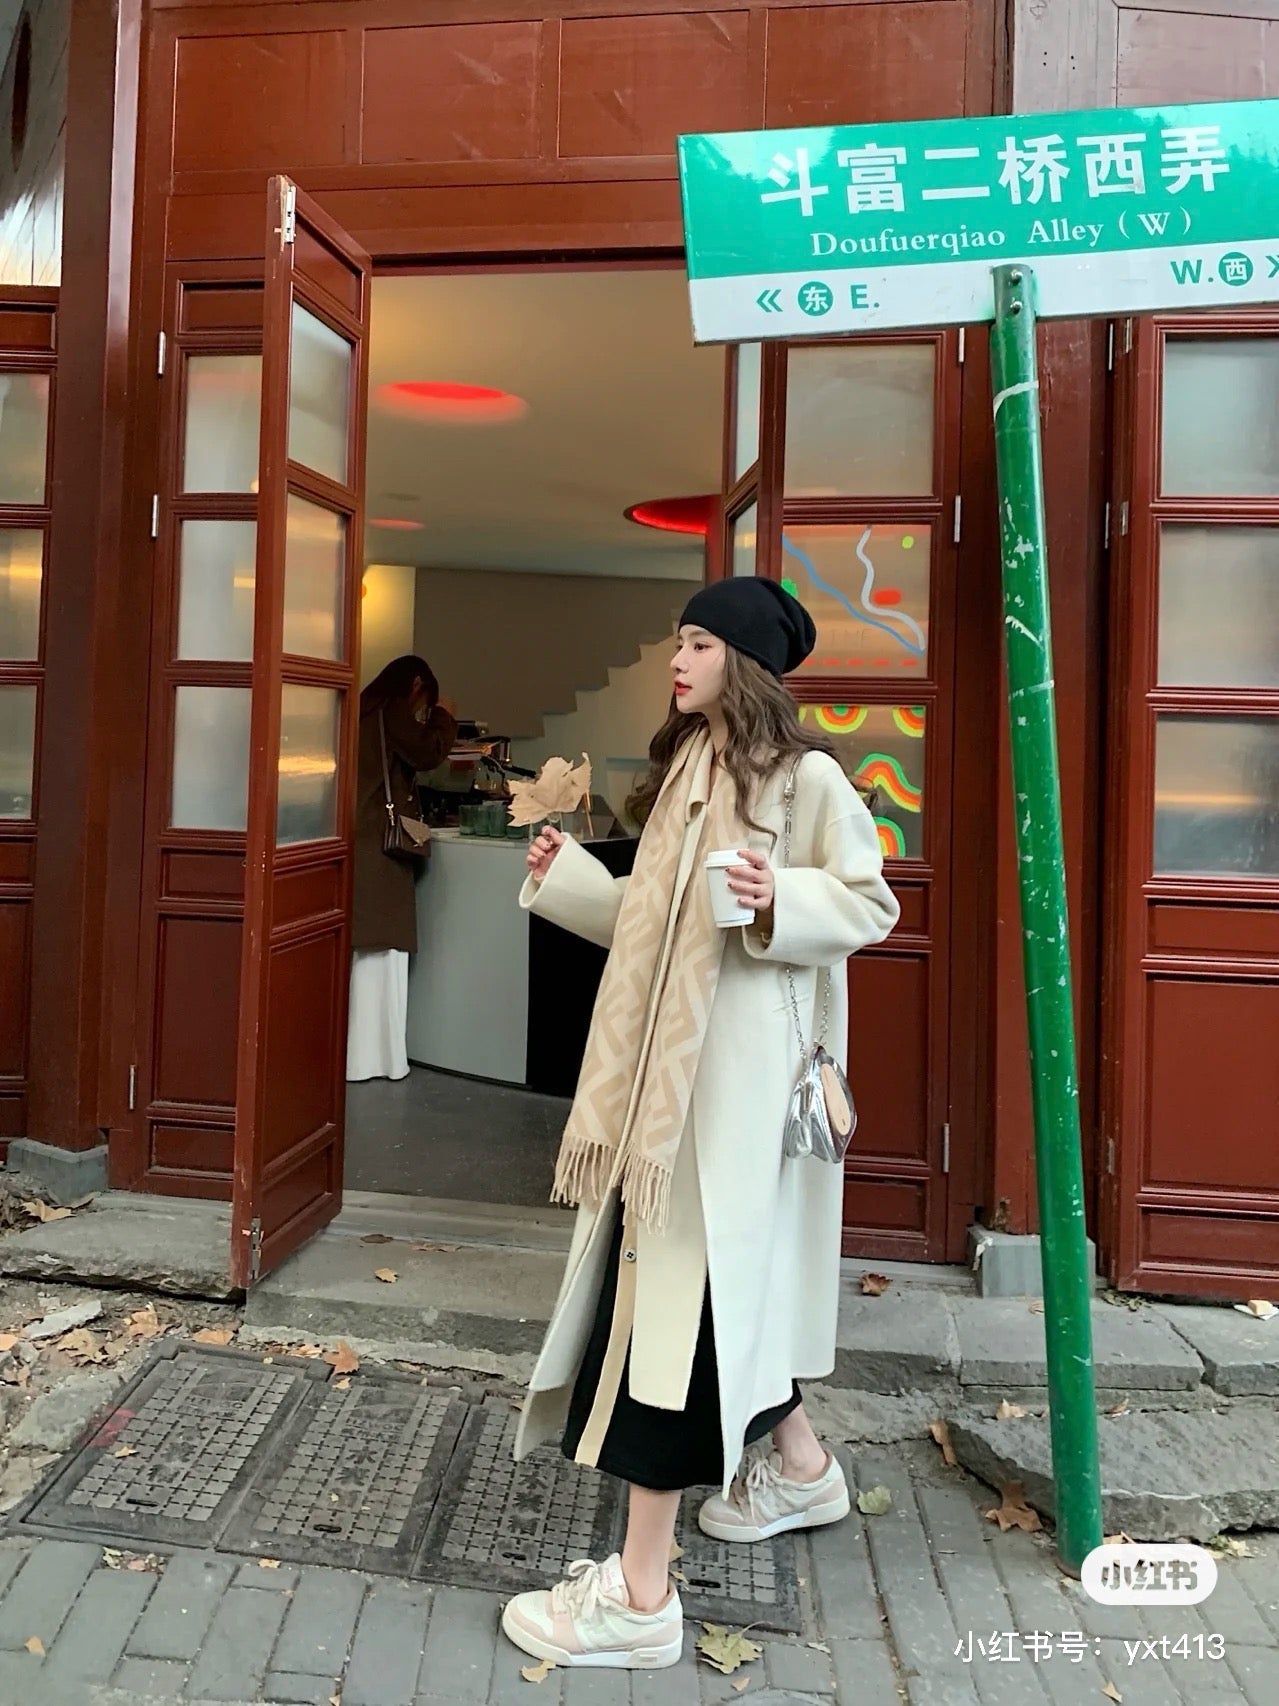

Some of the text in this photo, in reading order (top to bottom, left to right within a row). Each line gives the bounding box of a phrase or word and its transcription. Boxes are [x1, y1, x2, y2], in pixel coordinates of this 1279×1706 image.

[760, 125, 1231, 216] 斗富二桥西弄
[810, 225, 1006, 257] Doufuerqiao
[1027, 218, 1104, 248] Alley
[1223, 257, 1249, 282] 西
[802, 286, 830, 311] 东
